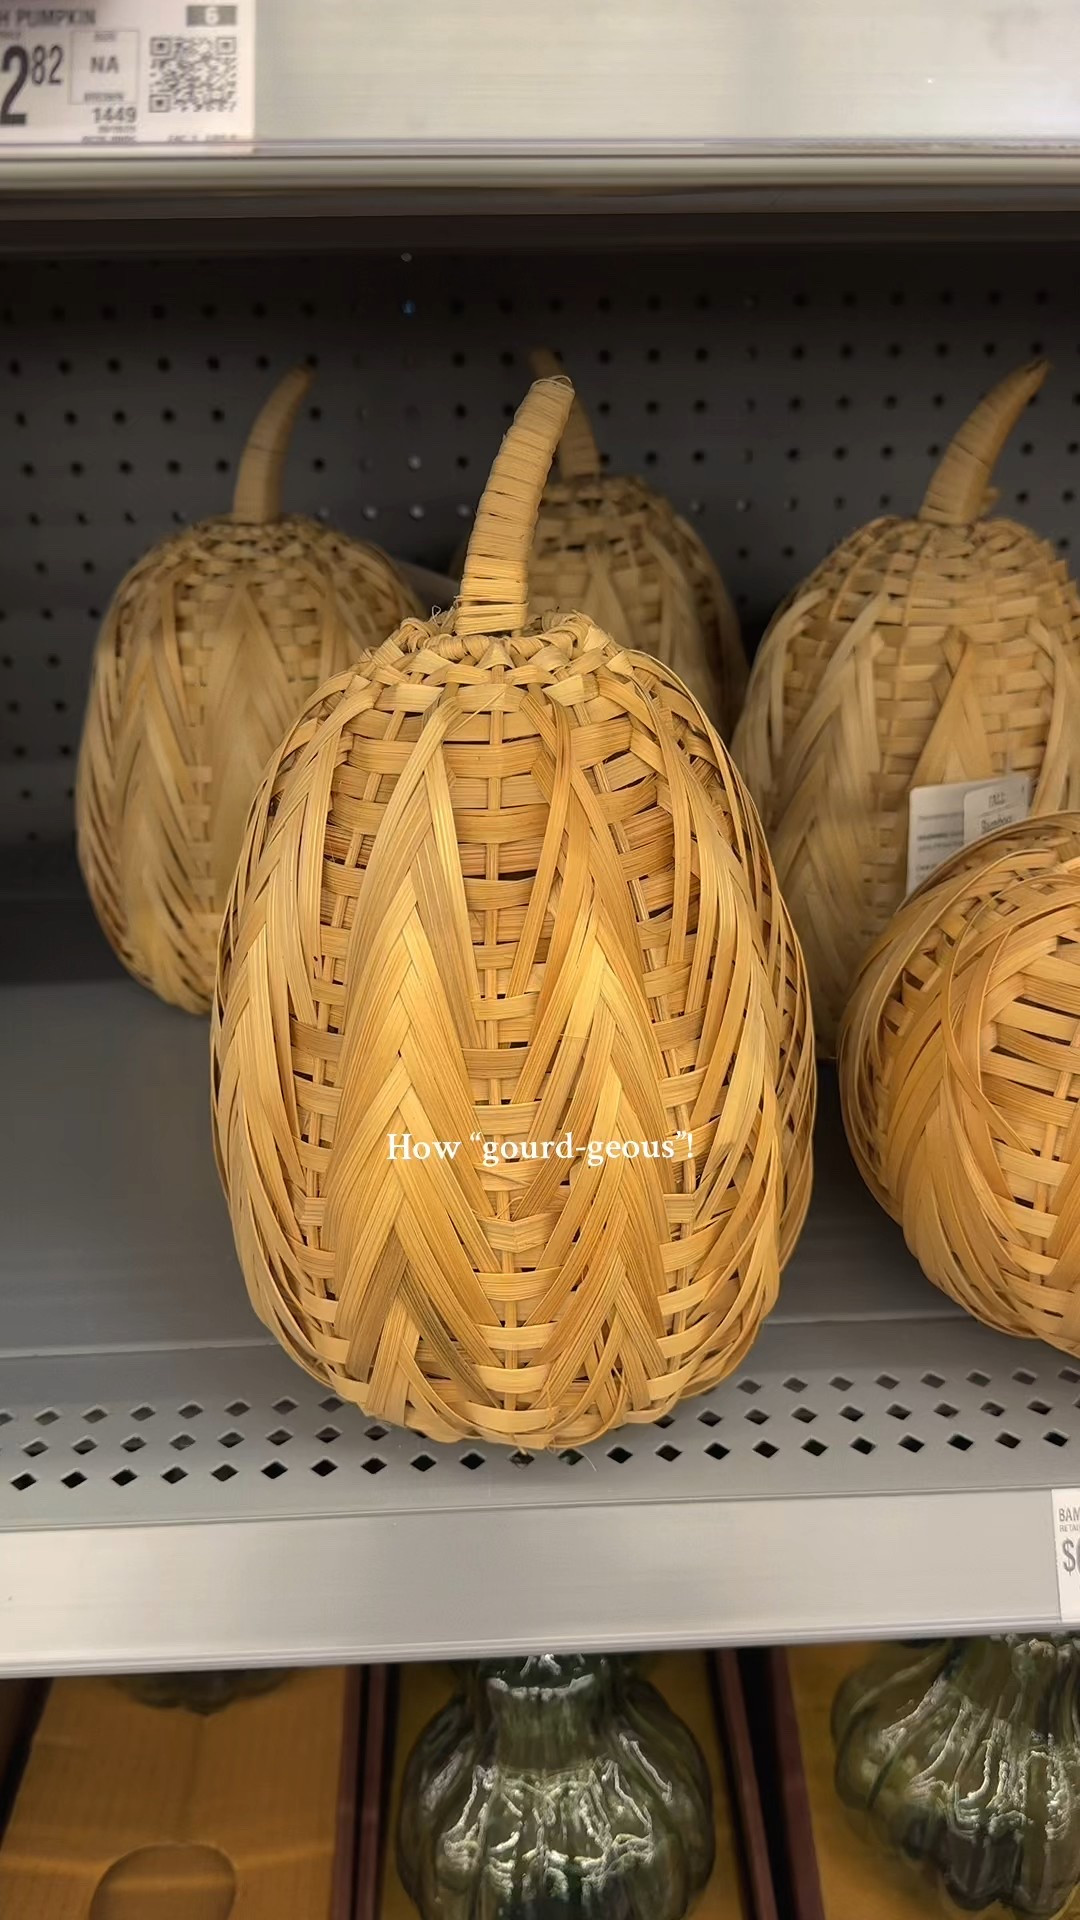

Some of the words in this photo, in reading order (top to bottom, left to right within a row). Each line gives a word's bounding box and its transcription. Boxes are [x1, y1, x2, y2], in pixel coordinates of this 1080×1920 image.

[17, 9, 96, 27] PUMPKIN
[204, 7, 220, 25] 6
[90, 56, 119, 74] NA
[92, 106, 137, 123] 1449
